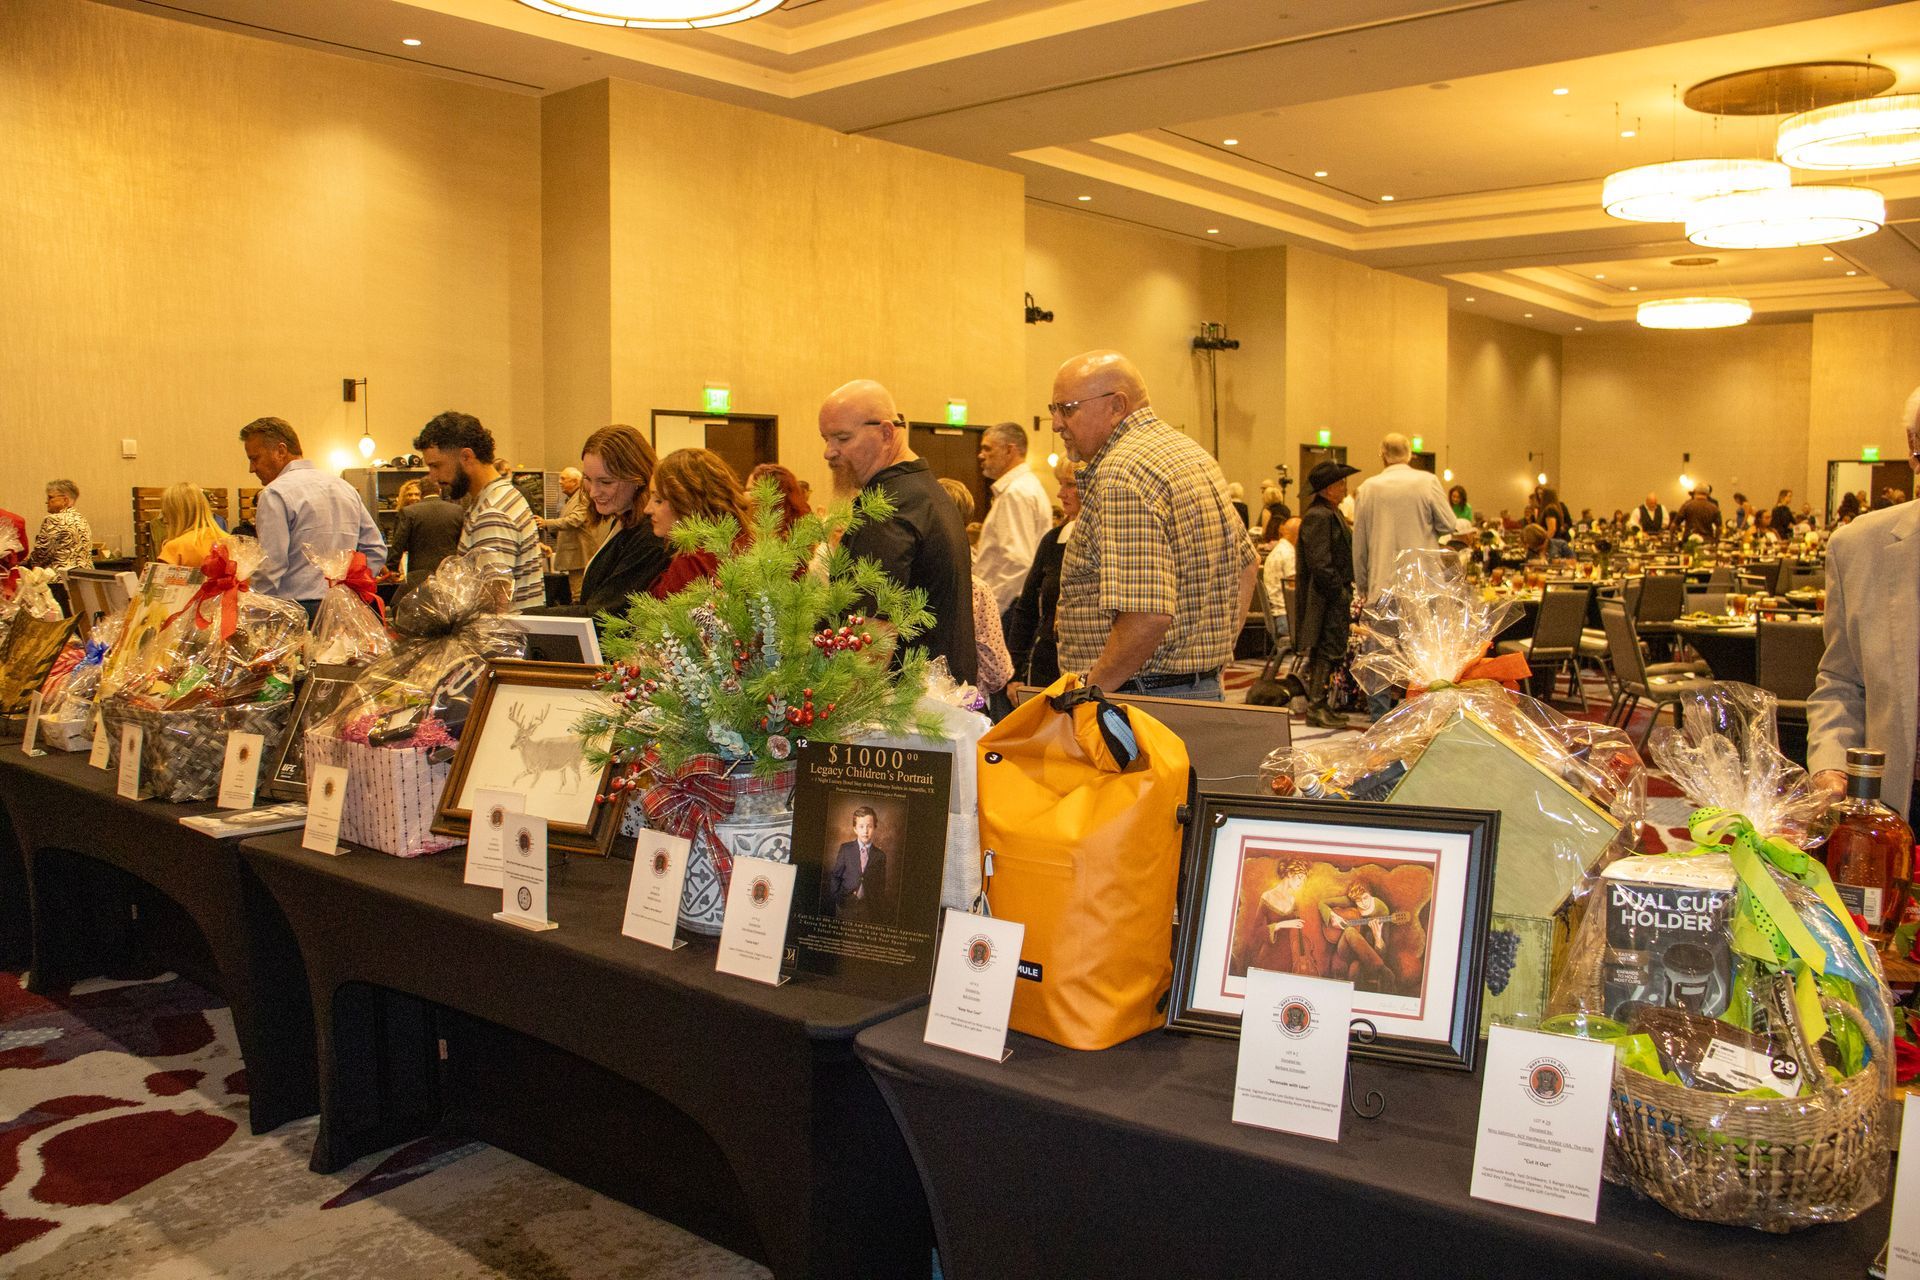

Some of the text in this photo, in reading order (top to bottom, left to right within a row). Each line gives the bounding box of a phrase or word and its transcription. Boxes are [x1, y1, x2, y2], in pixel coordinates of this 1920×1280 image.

[282, 764, 297, 772] UFC
[810, 763, 933, 784] Legacy Children's Portrait
[1215, 813, 1223, 823] 7
[1612, 890, 1724, 914] DUAL CUP
[1621, 910, 1713, 932] HOLDER
[1773, 1060, 1797, 1074] 29
